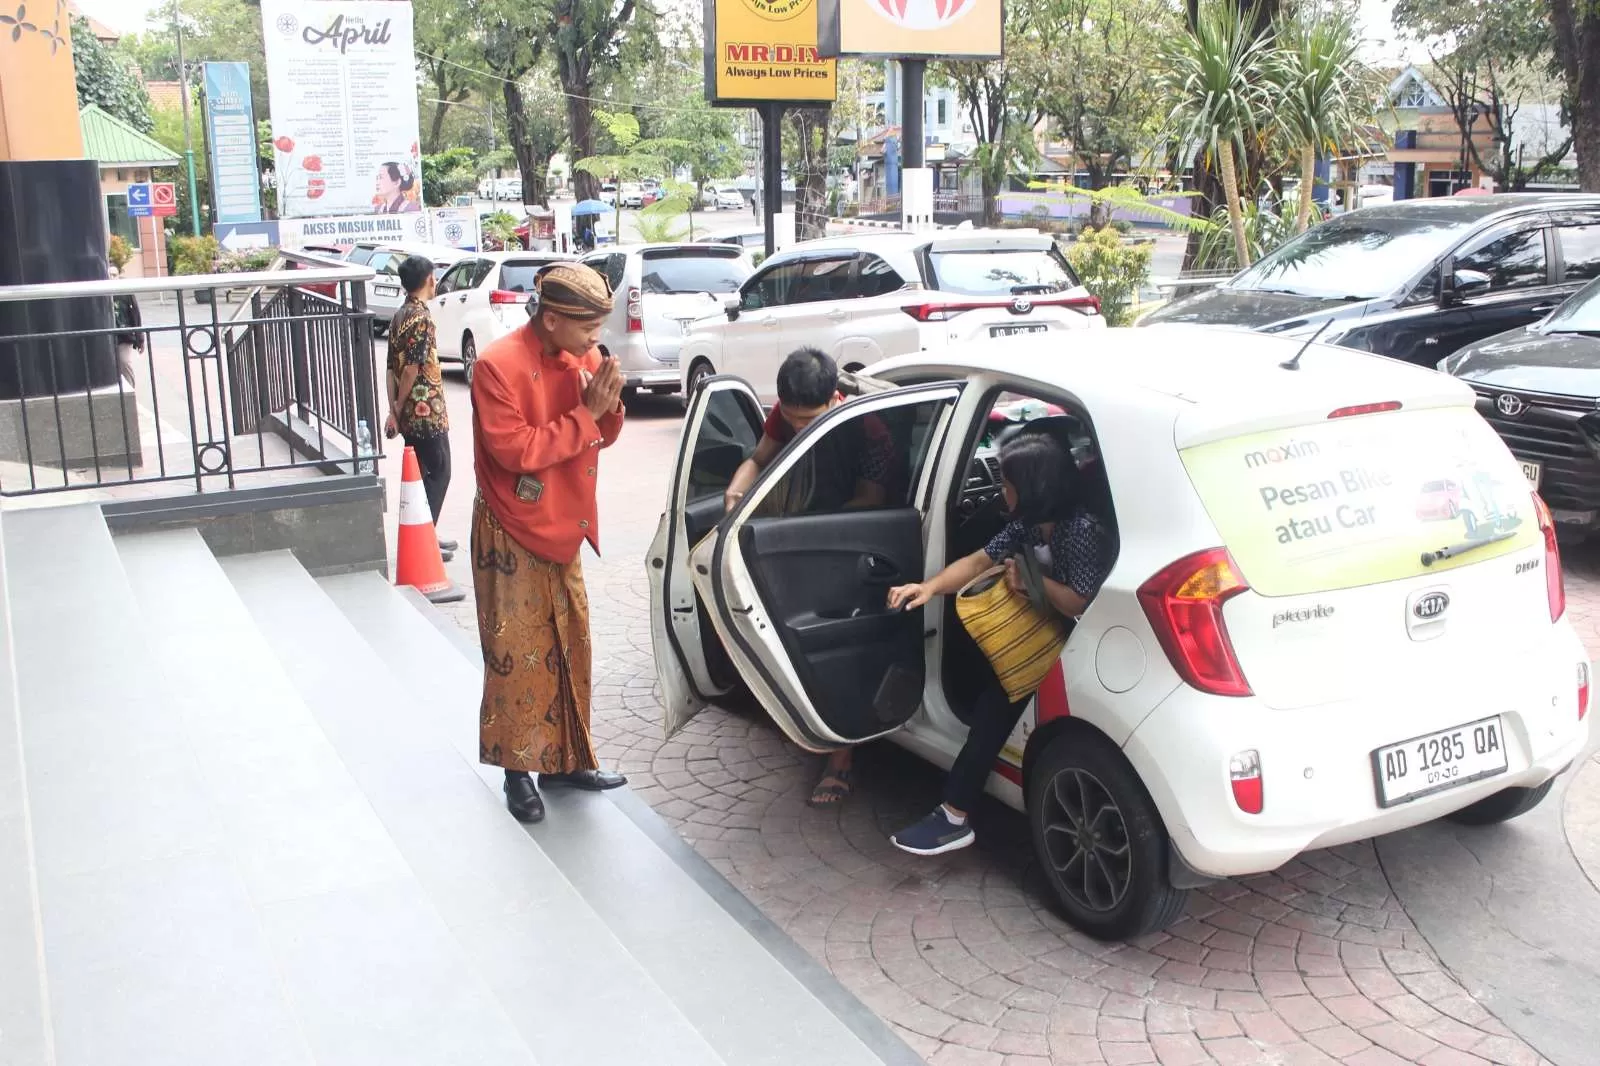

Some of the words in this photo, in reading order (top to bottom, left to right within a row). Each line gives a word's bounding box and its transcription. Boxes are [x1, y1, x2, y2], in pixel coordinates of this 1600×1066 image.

[768, 5, 788, 14] Low
[303, 14, 391, 55] April
[725, 66, 767, 79] Always
[769, 67, 791, 77] Low
[794, 68, 828, 79] Prices
[303, 222, 336, 236] AKSES
[338, 220, 375, 234] MASUK
[376, 219, 403, 231] MALL
[1259, 480, 1338, 511] Pesan
[1339, 467, 1393, 493] Bike
[1275, 515, 1333, 544] atau
[1335, 504, 1376, 529] Car
[1418, 598, 1445, 616] KIA
[1386, 749, 1408, 782] AD
[1417, 732, 1465, 771] 1285
[1473, 724, 1499, 755] QA
